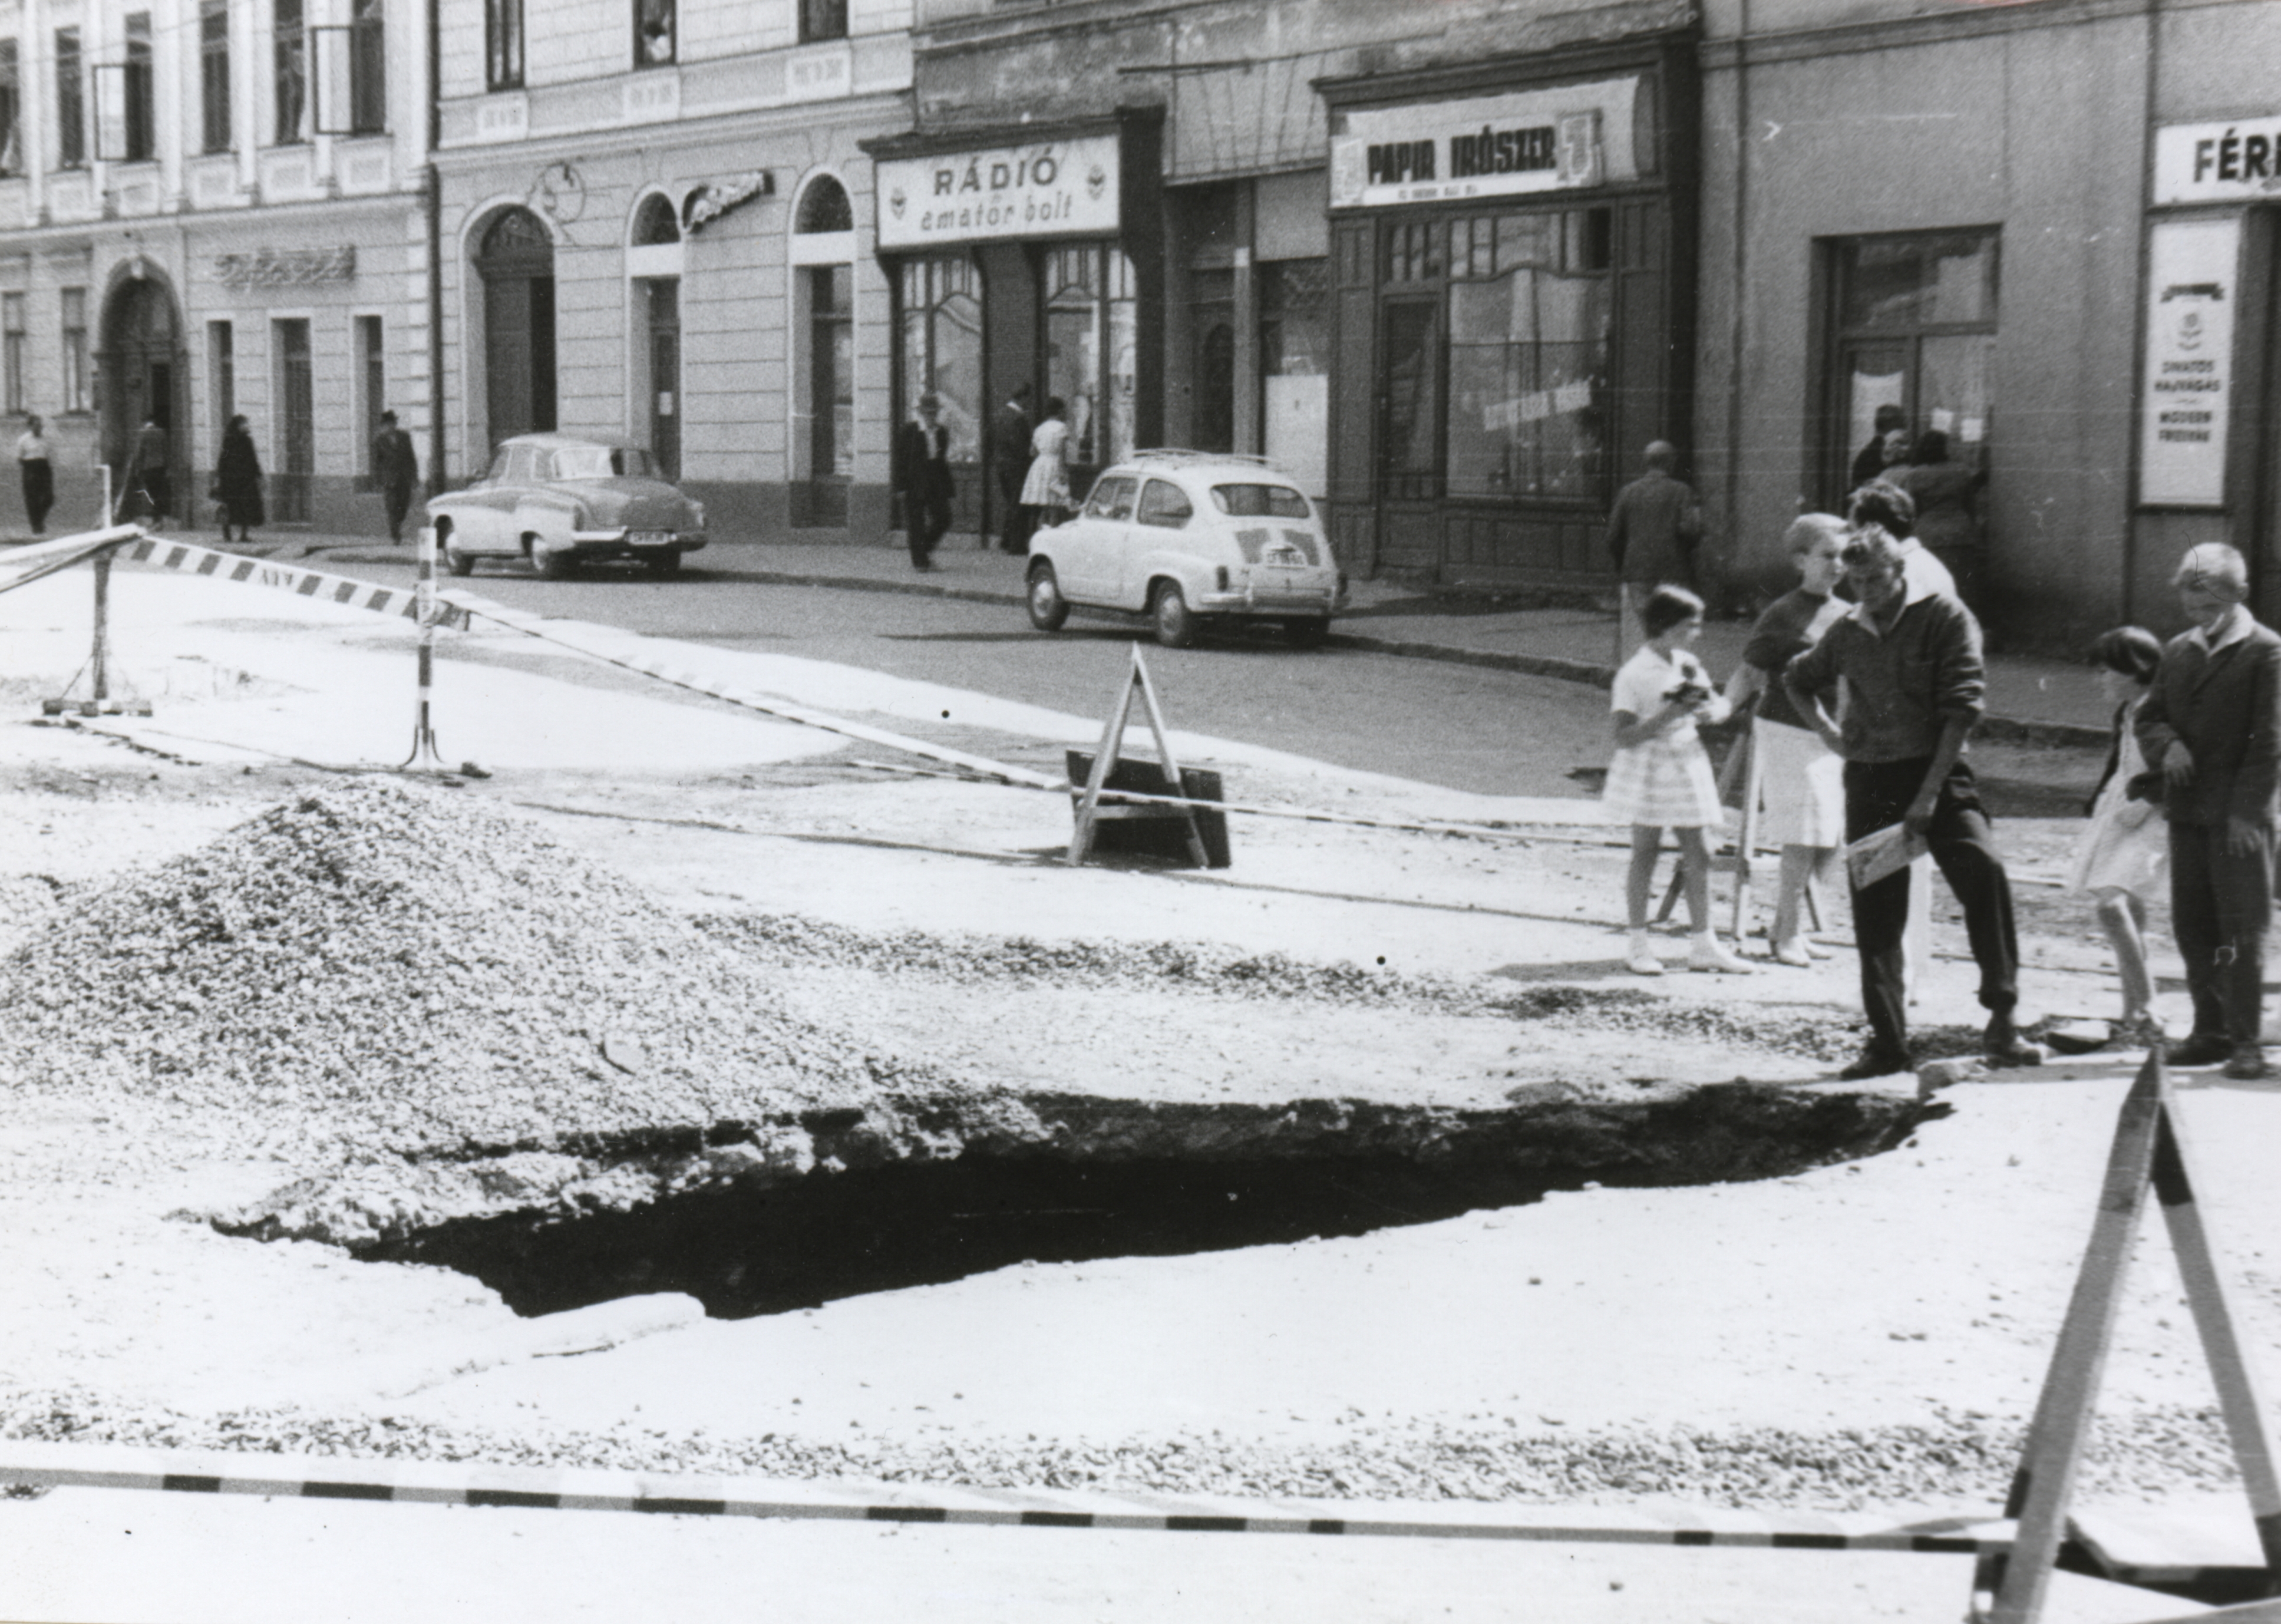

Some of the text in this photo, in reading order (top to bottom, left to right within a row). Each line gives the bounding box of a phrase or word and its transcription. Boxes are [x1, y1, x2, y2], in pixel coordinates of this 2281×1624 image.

[935, 147, 1058, 195] RÁDIÓ
[1450, 124, 1557, 179] IRÓSZER
[2193, 127, 2281, 183] FÉR
[1025, 192, 1072, 222] bolt
[2160, 411, 2211, 424] MODERN
